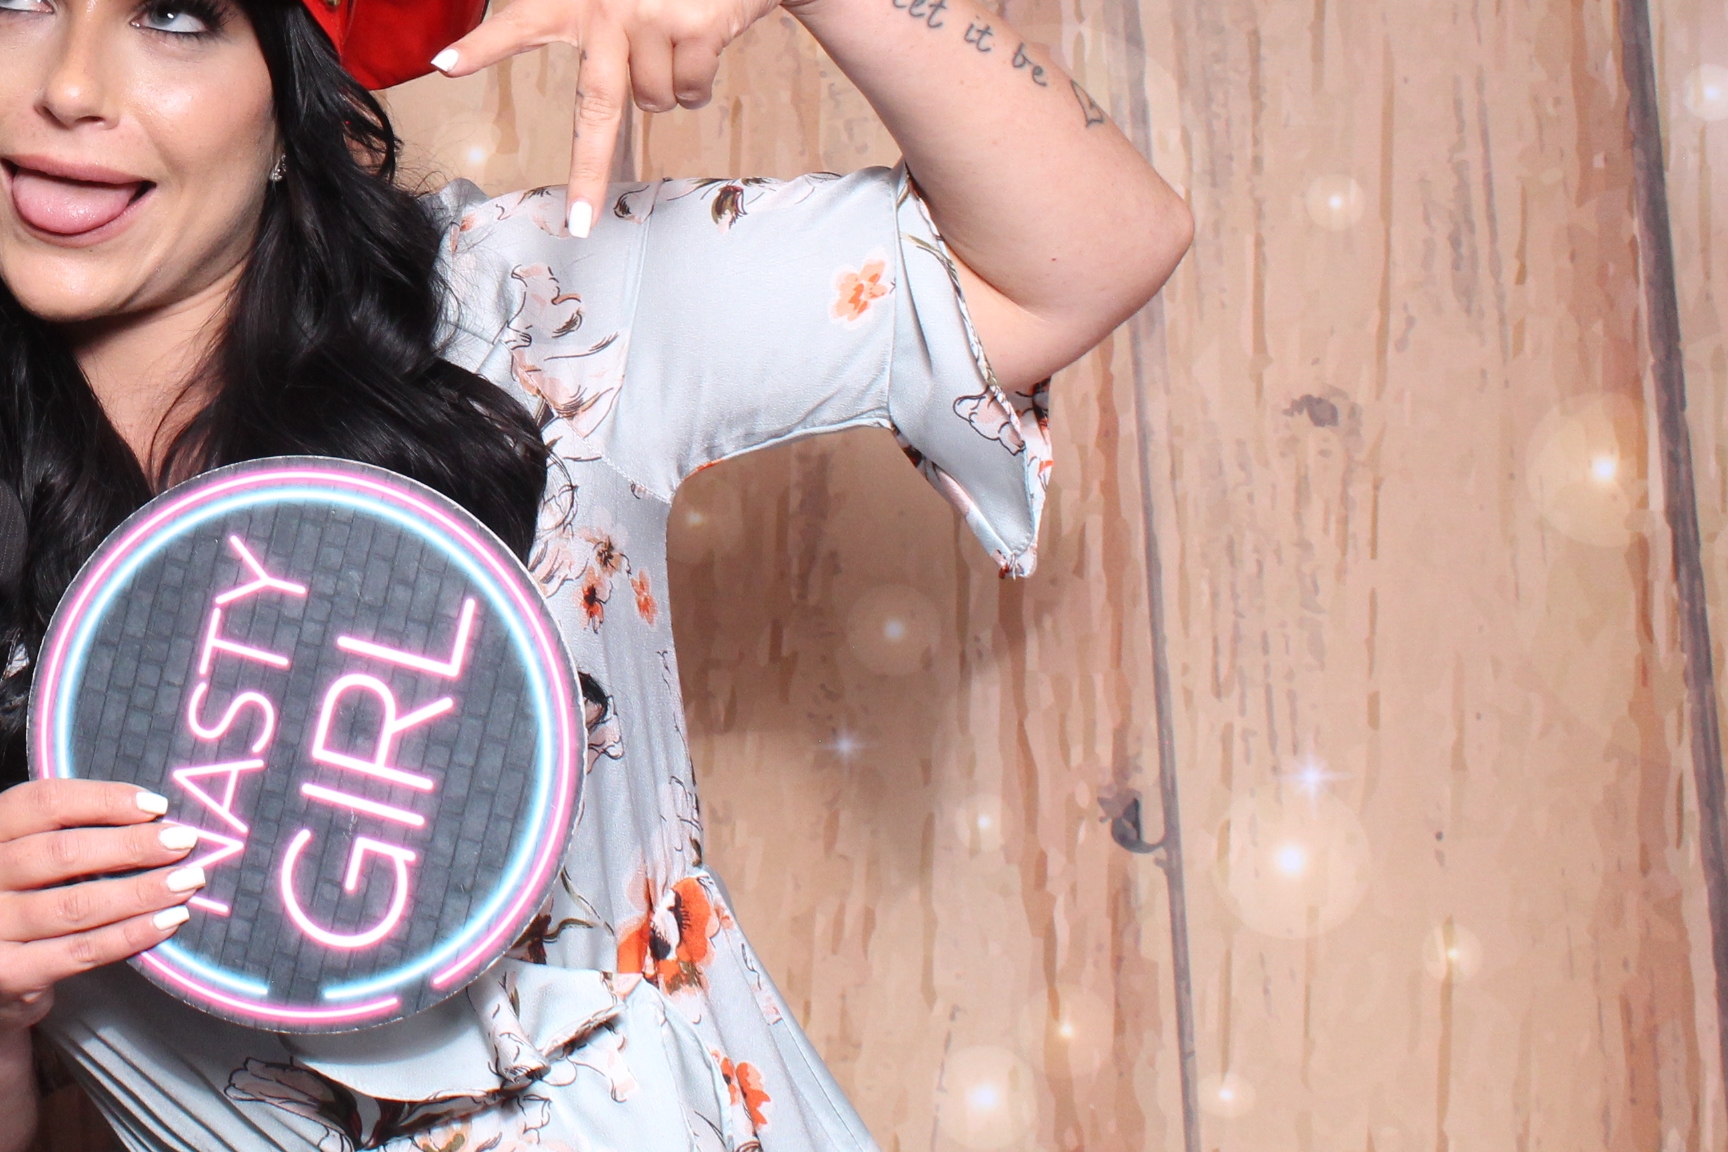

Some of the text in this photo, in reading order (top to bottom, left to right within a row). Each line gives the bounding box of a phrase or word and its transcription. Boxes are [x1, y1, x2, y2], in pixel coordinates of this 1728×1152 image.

[963, 14, 994, 53] it
[1011, 42, 1048, 87] be
[279, 597, 476, 948] GIRL
